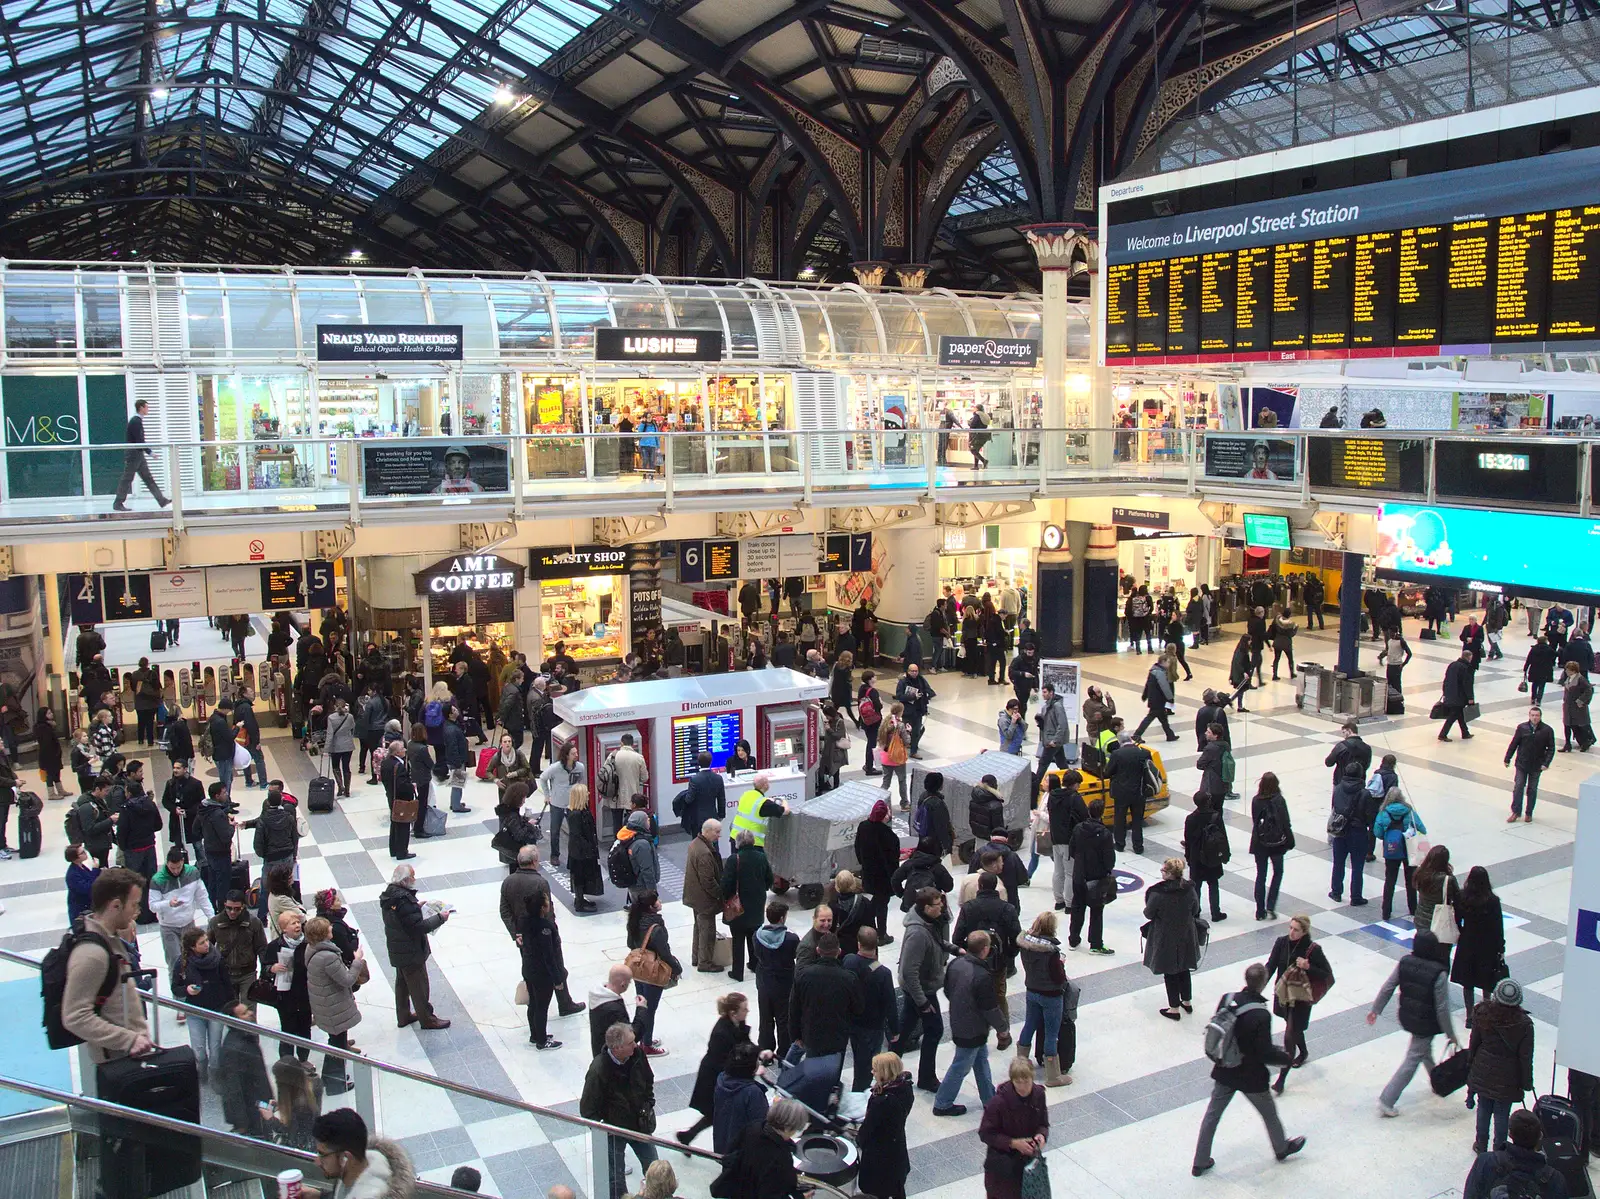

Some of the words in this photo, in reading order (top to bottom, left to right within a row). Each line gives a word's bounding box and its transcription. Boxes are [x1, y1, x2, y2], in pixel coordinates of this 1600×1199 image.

[1111, 184, 1144, 197] Departures
[1127, 236, 1170, 251] Welcome
[1172, 232, 1184, 244] to
[1185, 217, 1248, 244] Liverpool
[1250, 212, 1296, 234] Street
[1300, 204, 1359, 228] Station
[322, 333, 362, 344] NEAL'S
[364, 333, 396, 344] YARD
[398, 333, 458, 344] REMEDIES
[624, 337, 674, 353] LUSH
[434, 346, 456, 354] Beauty
[6, 414, 78, 443] M&S
[1479, 453, 1514, 470] 15:32
[856, 538, 867, 556] 7
[450, 556, 497, 572] AMT
[542, 557, 553, 565] The
[594, 552, 626, 562] SHOP
[686, 548, 698, 566] 6
[314, 569, 328, 589] 5
[430, 572, 514, 592] COFFEE
[77, 576, 95, 603] 4
[633, 591, 650, 602] POTS
[651, 590, 658, 600] OF
[690, 699, 732, 709] Information
